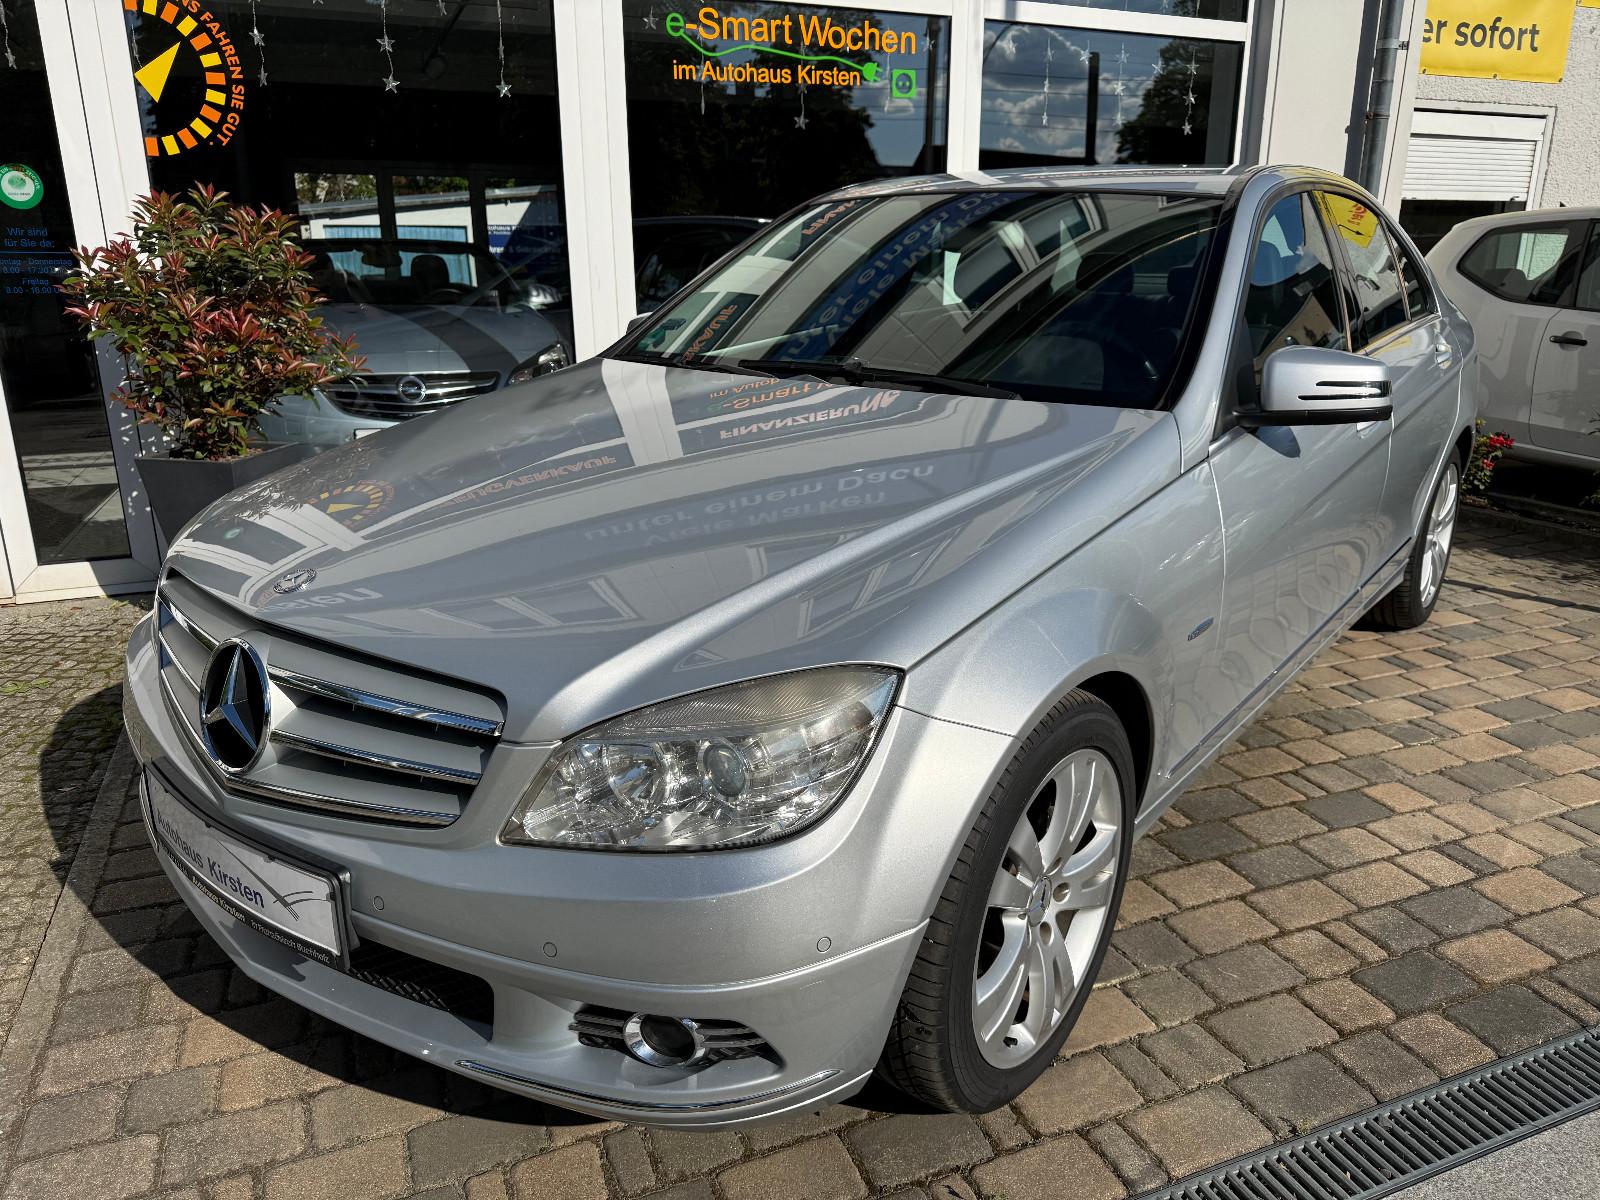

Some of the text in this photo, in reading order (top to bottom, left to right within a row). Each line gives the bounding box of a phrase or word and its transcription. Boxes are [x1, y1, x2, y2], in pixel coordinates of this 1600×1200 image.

[666, 7, 916, 54] e-Smart Wochen
[1454, 16, 1540, 52] sofort
[200, 11, 243, 79] FAHREN
[231, 84, 245, 110] SIE
[673, 60, 861, 86] im Autohaus Kirsten
[4, 238, 17, 247] für
[20, 239, 37, 247] Sie
[7, 227, 48, 236] Wir sind
[157, 808, 204, 869] Autohaus
[207, 857, 265, 909] Kirsten
